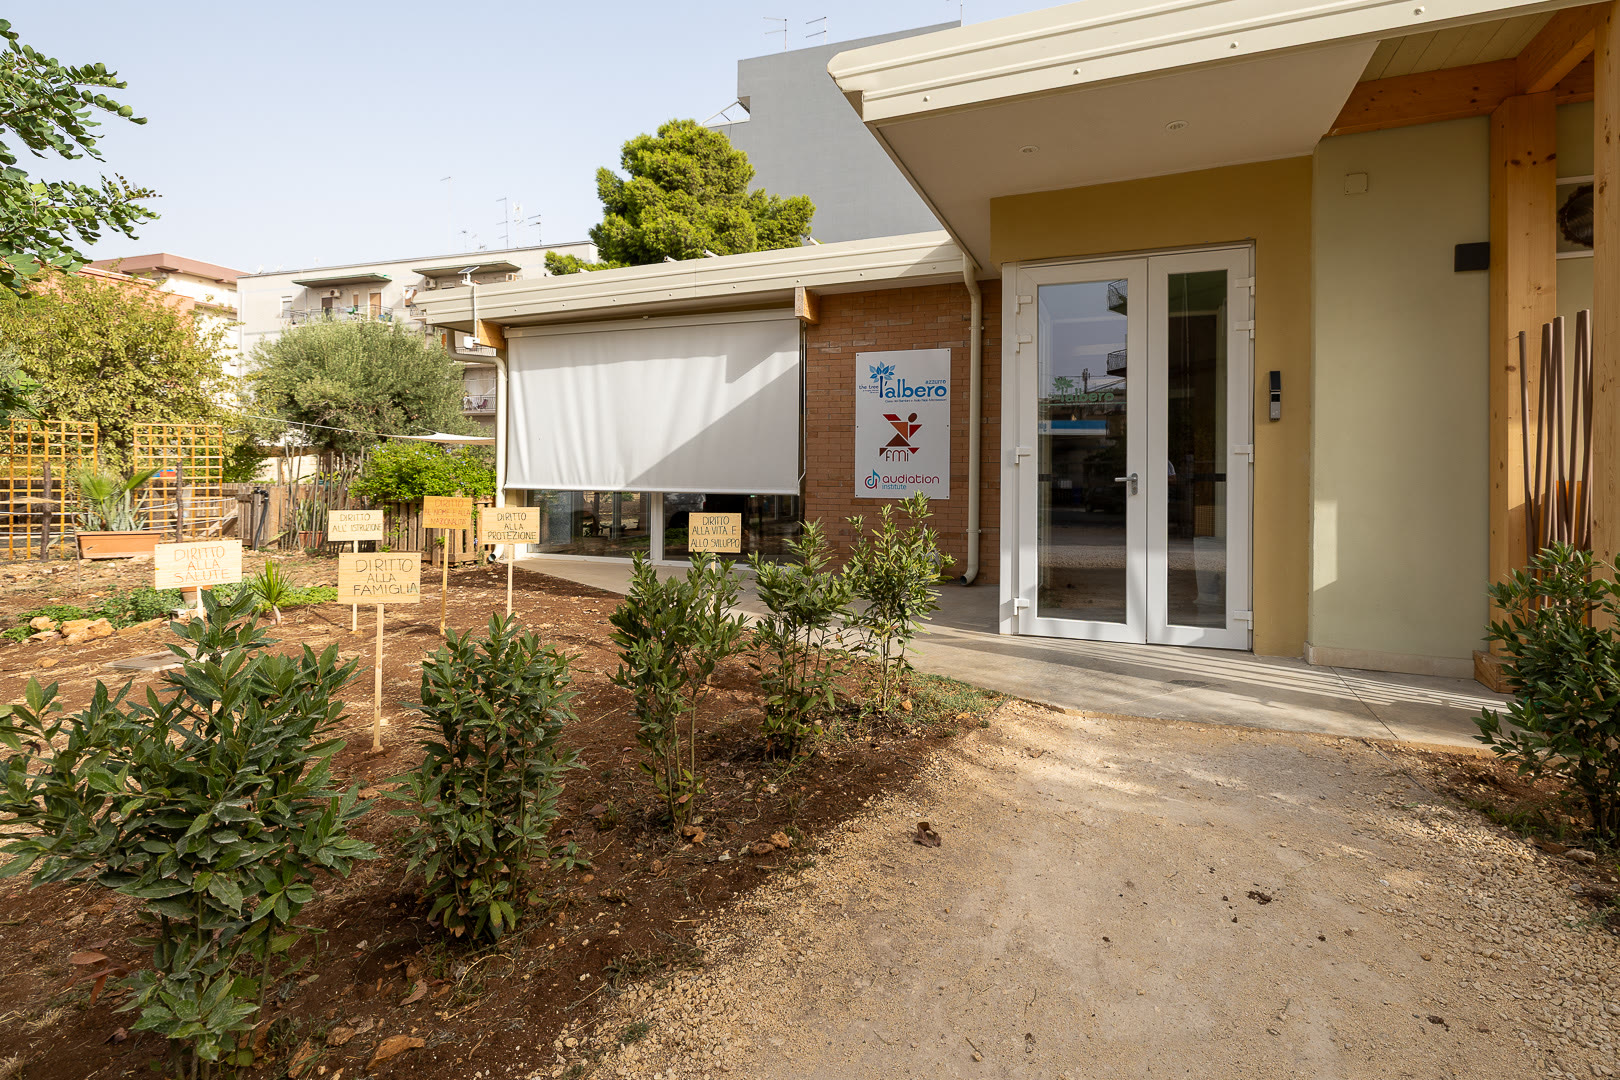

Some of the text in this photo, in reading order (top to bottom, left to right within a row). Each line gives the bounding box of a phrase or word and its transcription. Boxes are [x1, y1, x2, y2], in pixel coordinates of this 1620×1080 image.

[880, 376, 947, 398] l'albero
[885, 449, 909, 462] fmi
[882, 474, 940, 484] audiation
[434, 498, 465, 508] DIRITTO
[339, 512, 371, 522] DIRITTO
[496, 511, 527, 521] DIRITTO
[702, 516, 730, 526] DIRITTO
[503, 522, 524, 531] ALLA
[692, 526, 710, 535] ALLA
[712, 526, 728, 534] VITA
[487, 531, 537, 541] PROTEZIONE
[690, 538, 740, 548] ALLO SVILUPPO
[174, 545, 225, 562] DIRITTO
[187, 558, 221, 571] ALLA
[355, 558, 414, 573] DIRITTO
[172, 568, 231, 584] SALUTE
[366, 572, 397, 584] ALLA
[353, 582, 419, 596] FAMIGLIA
